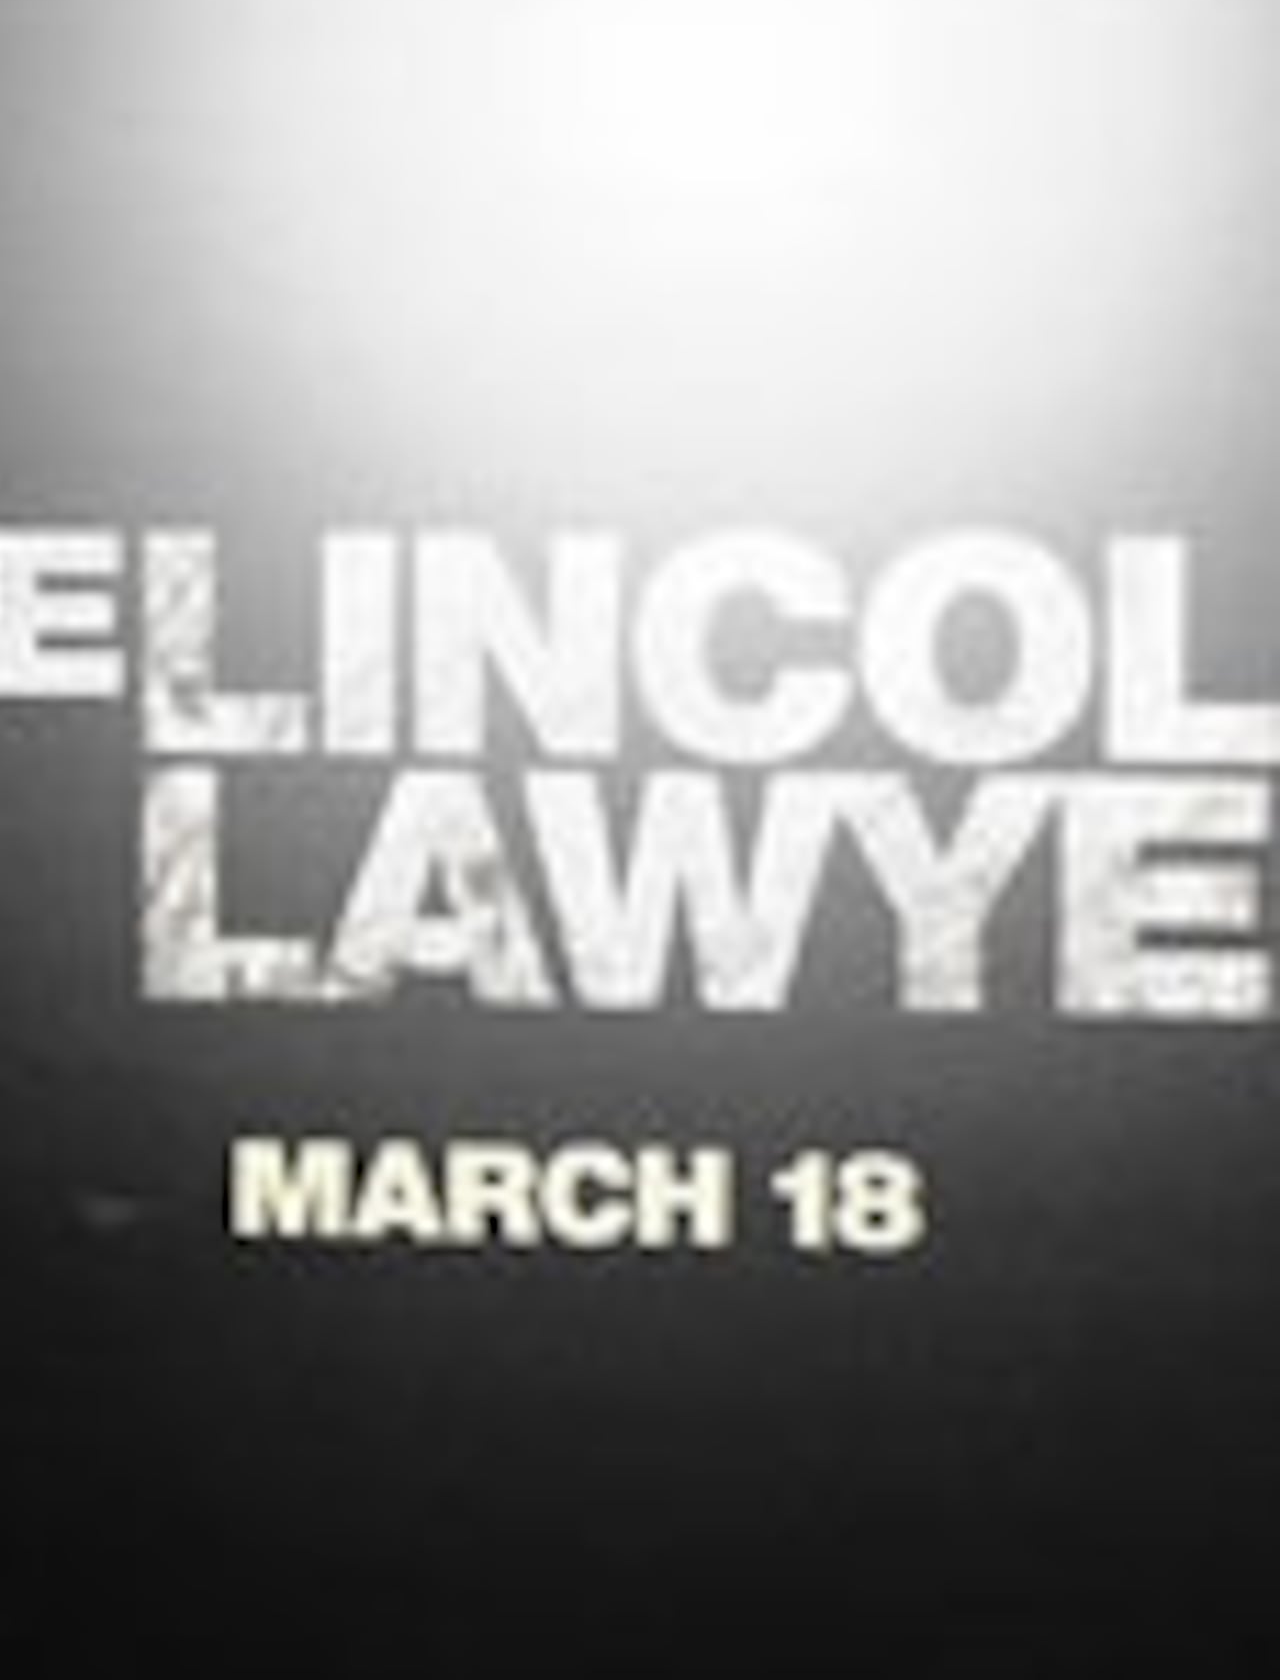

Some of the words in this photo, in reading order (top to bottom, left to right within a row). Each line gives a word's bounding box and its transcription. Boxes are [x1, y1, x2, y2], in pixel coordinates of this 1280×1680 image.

[142, 525, 1280, 767] LINCOL
[140, 765, 1274, 1019] LAWYE
[230, 1136, 734, 1249] MARCH
[770, 1149, 926, 1252] 18
